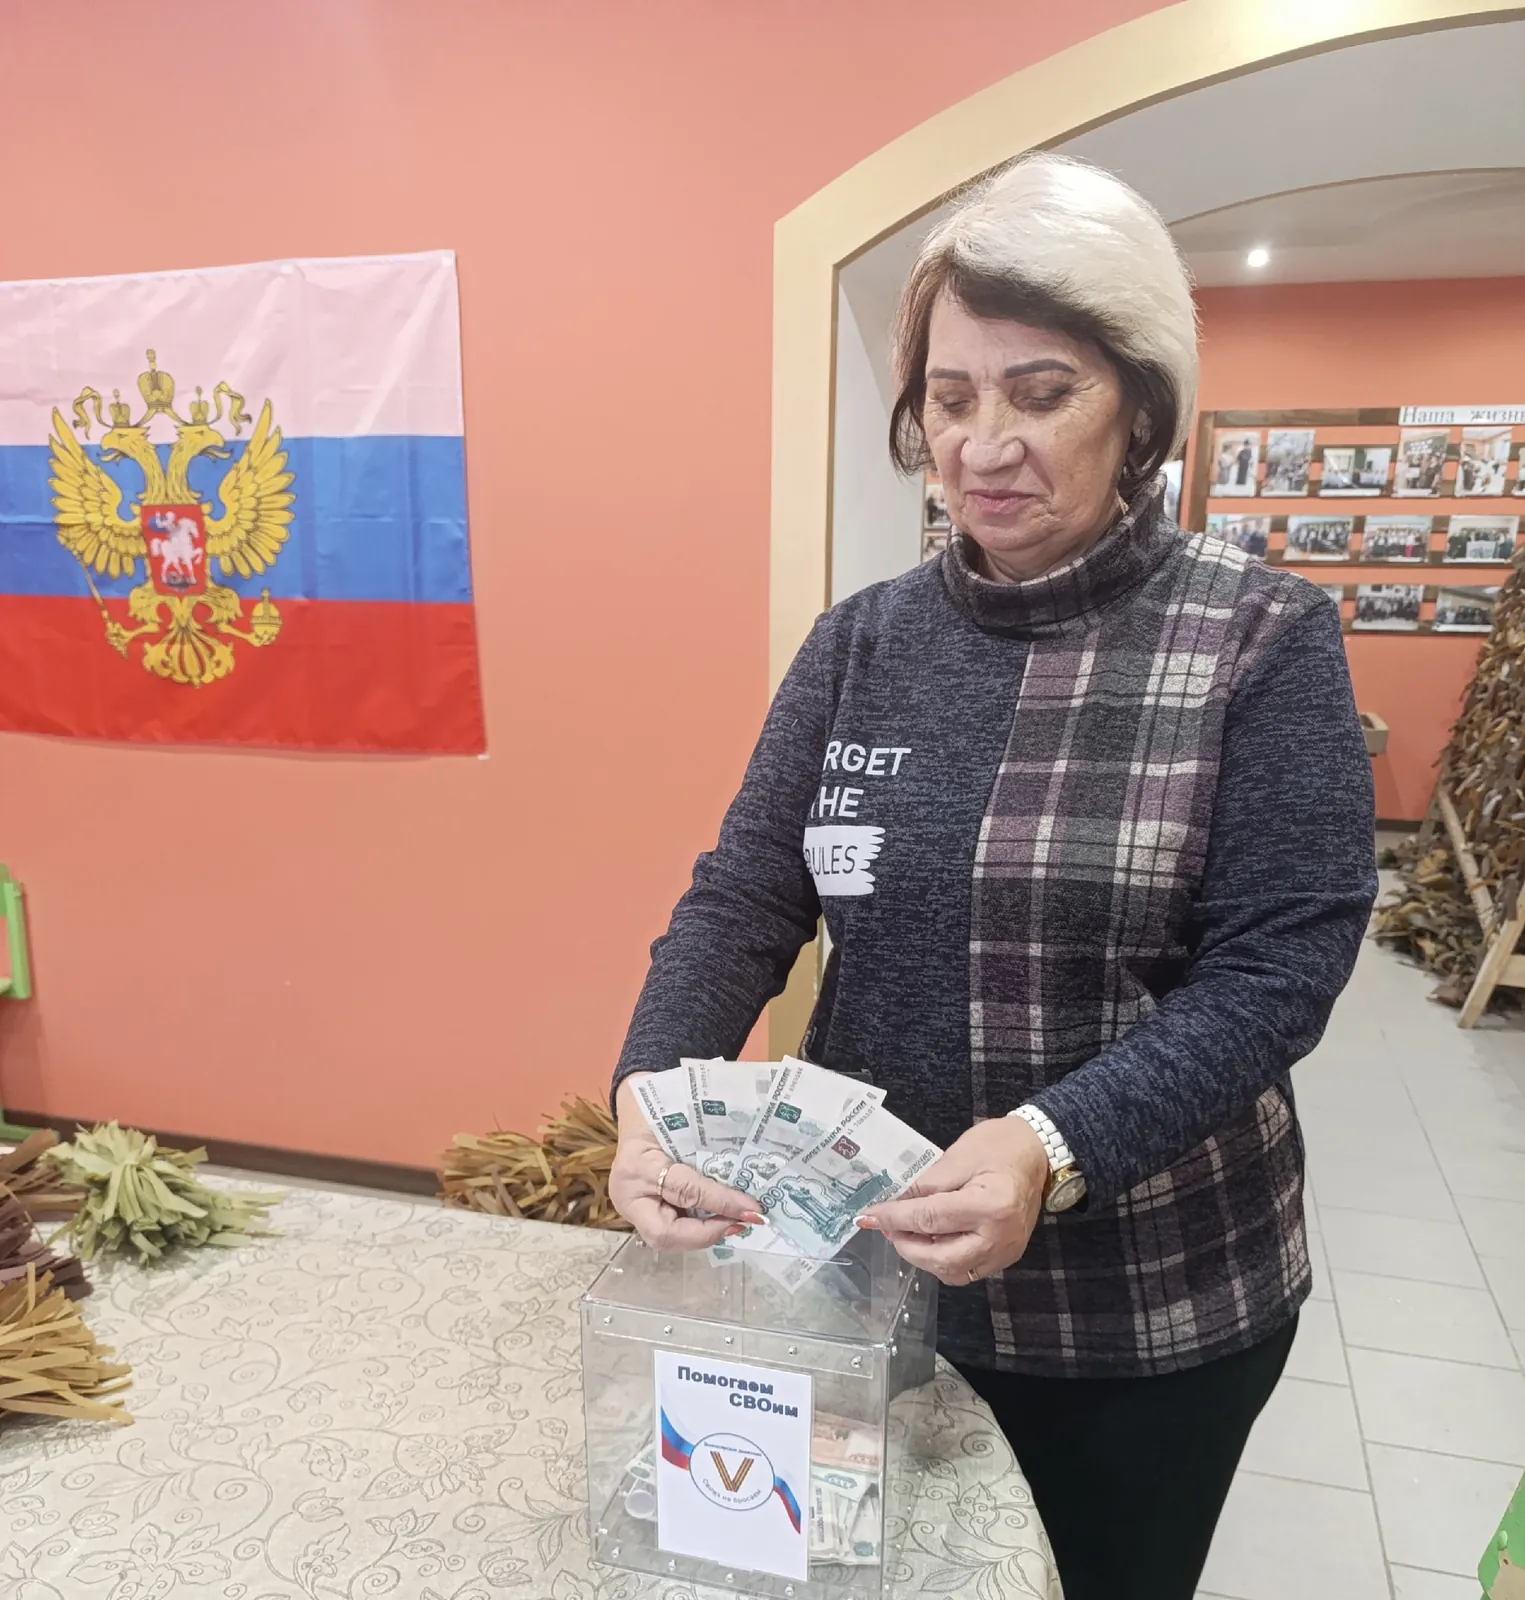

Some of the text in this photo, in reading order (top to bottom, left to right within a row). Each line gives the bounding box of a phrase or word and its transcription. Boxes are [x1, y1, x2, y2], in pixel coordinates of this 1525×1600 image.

[1402, 406, 1455, 424] Наша
[823, 741, 912, 776] RGET
[811, 786, 864, 818] HE
[820, 1126, 842, 1149] БАНКА
[840, 1100, 867, 1127] РОССИИ
[733, 1168, 754, 1191] 00
[677, 1365, 774, 1395] Помогаем
[729, 1392, 798, 1418] СВОим
